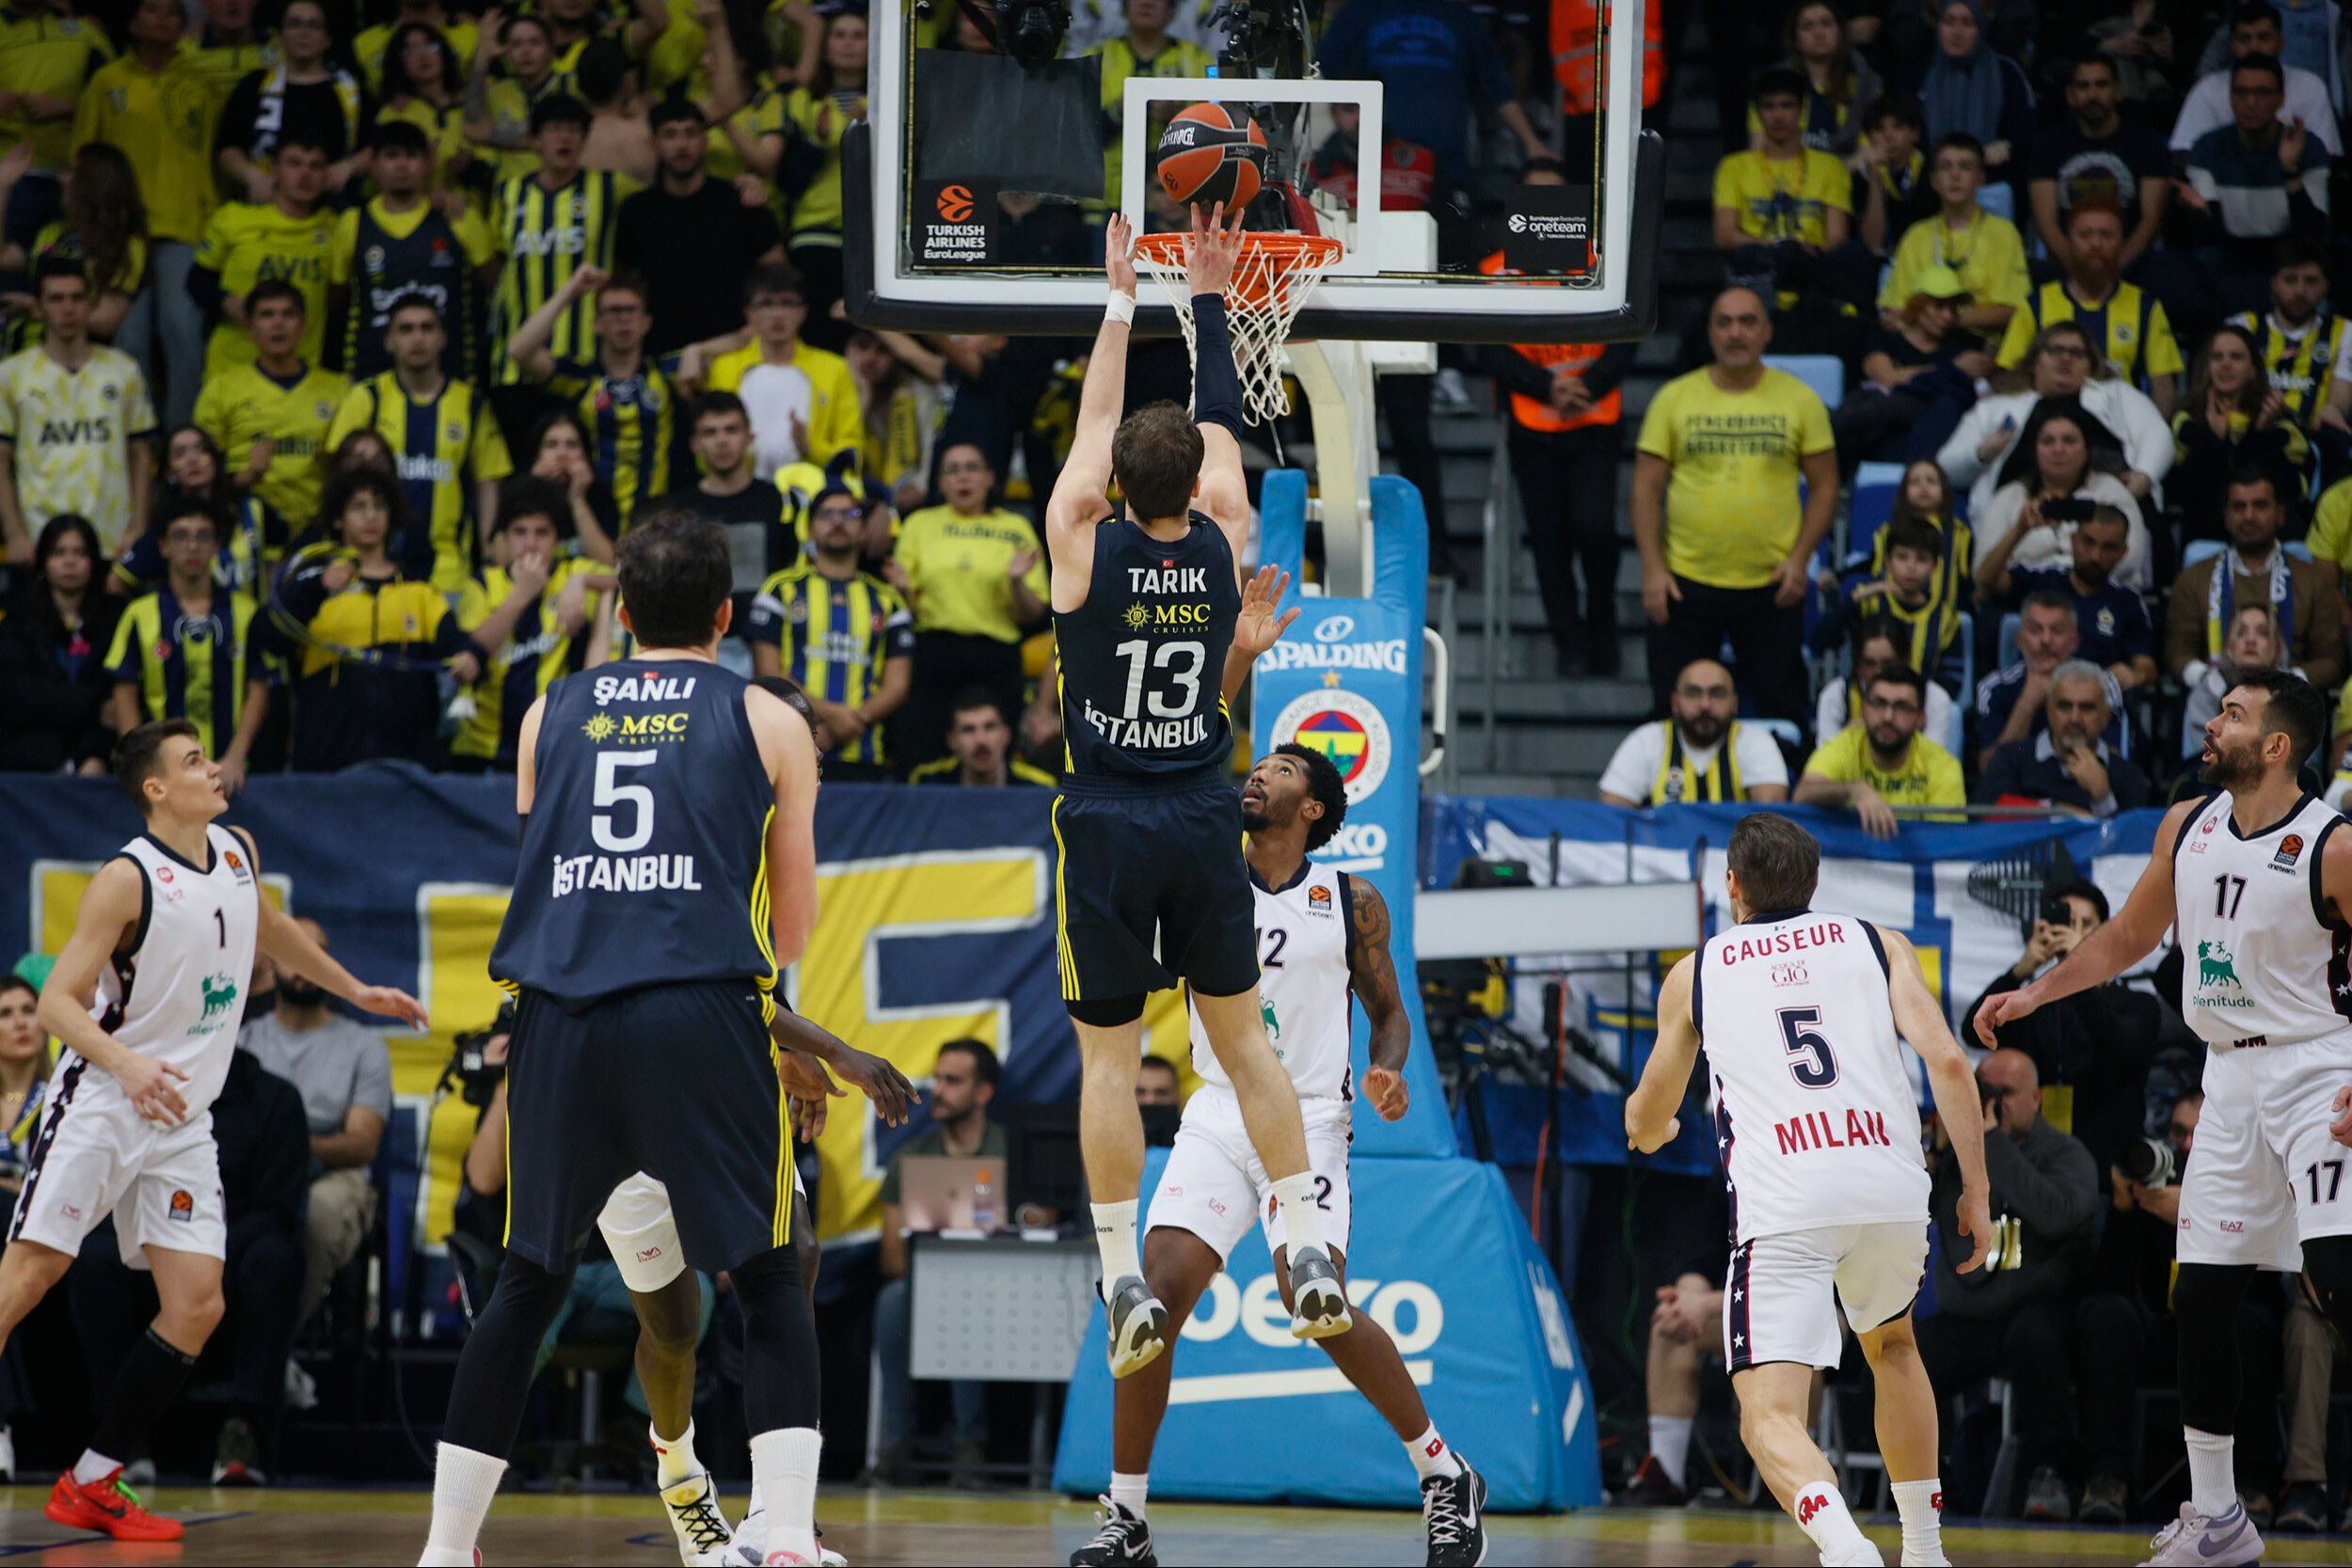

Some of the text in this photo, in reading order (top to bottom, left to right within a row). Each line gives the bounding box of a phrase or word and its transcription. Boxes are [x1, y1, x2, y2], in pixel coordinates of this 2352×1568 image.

[514, 227, 584, 258] AVIS
[925, 237, 987, 248] AIRLINES
[926, 225, 985, 236] TURKISH
[256, 254, 323, 283] AVIS
[923, 248, 987, 261] EuroLeague
[40, 419, 112, 446] AVIS
[1127, 567, 1207, 594] TARIK
[1153, 604, 1212, 625] MSC
[1153, 625, 1210, 634] CRUISES
[1258, 638, 1408, 675] SPALDING
[593, 675, 697, 706] ŞANLI
[1115, 639, 1207, 721] 13
[619, 712, 690, 736] MSC
[617, 734, 686, 744] CRUISES
[591, 749, 658, 852] 5
[2214, 872, 2249, 922] 17
[214, 907, 226, 950] 1
[1722, 922, 1846, 967] CAUSEUR
[2192, 994, 2255, 1008] plenitude
[1774, 1004, 1841, 1090] 5
[1773, 1108, 1891, 1156] MILAN
[2306, 1158, 2345, 1206] 17
[1208, 1196, 1227, 1216] EA7
